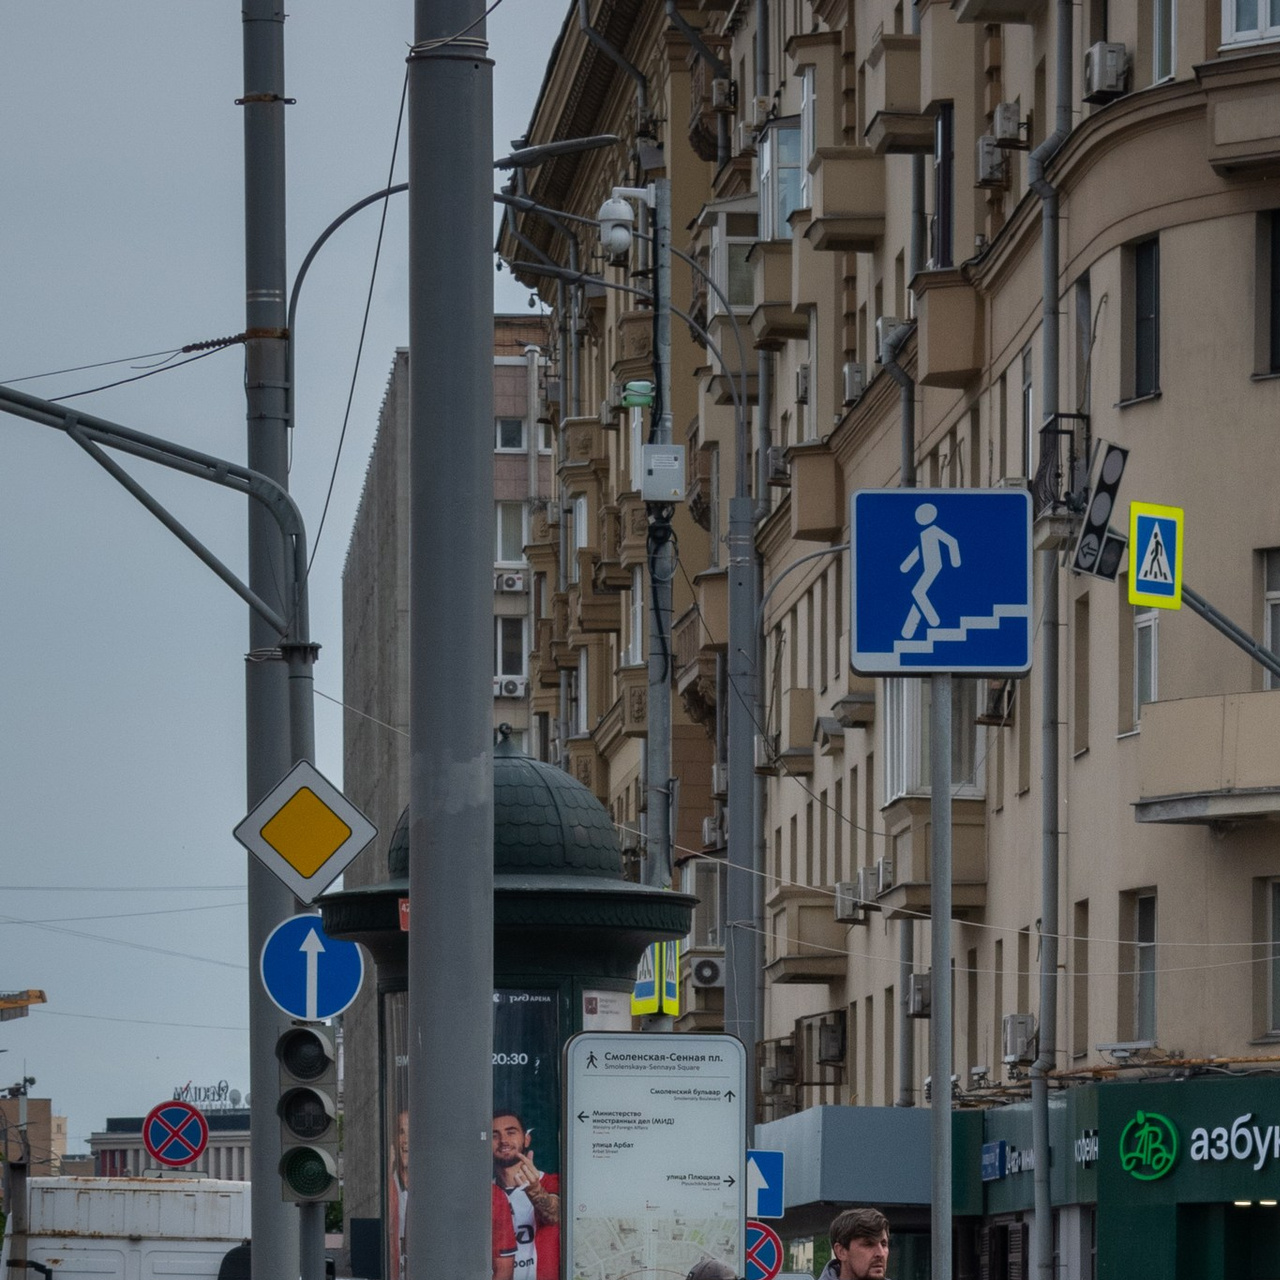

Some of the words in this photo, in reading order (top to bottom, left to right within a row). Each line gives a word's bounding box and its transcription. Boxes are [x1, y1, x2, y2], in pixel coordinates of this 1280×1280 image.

[493, 1054, 528, 1065] 20:30
[604, 1052, 706, 1062] Смоленская-Сенная
[708, 1054, 723, 1062] пл.
[650, 1088, 691, 1096] Смоленский
[593, 1110, 641, 1118] Министерство
[614, 1141, 634, 1149] Арбат
[689, 1173, 720, 1182] Плющиха
